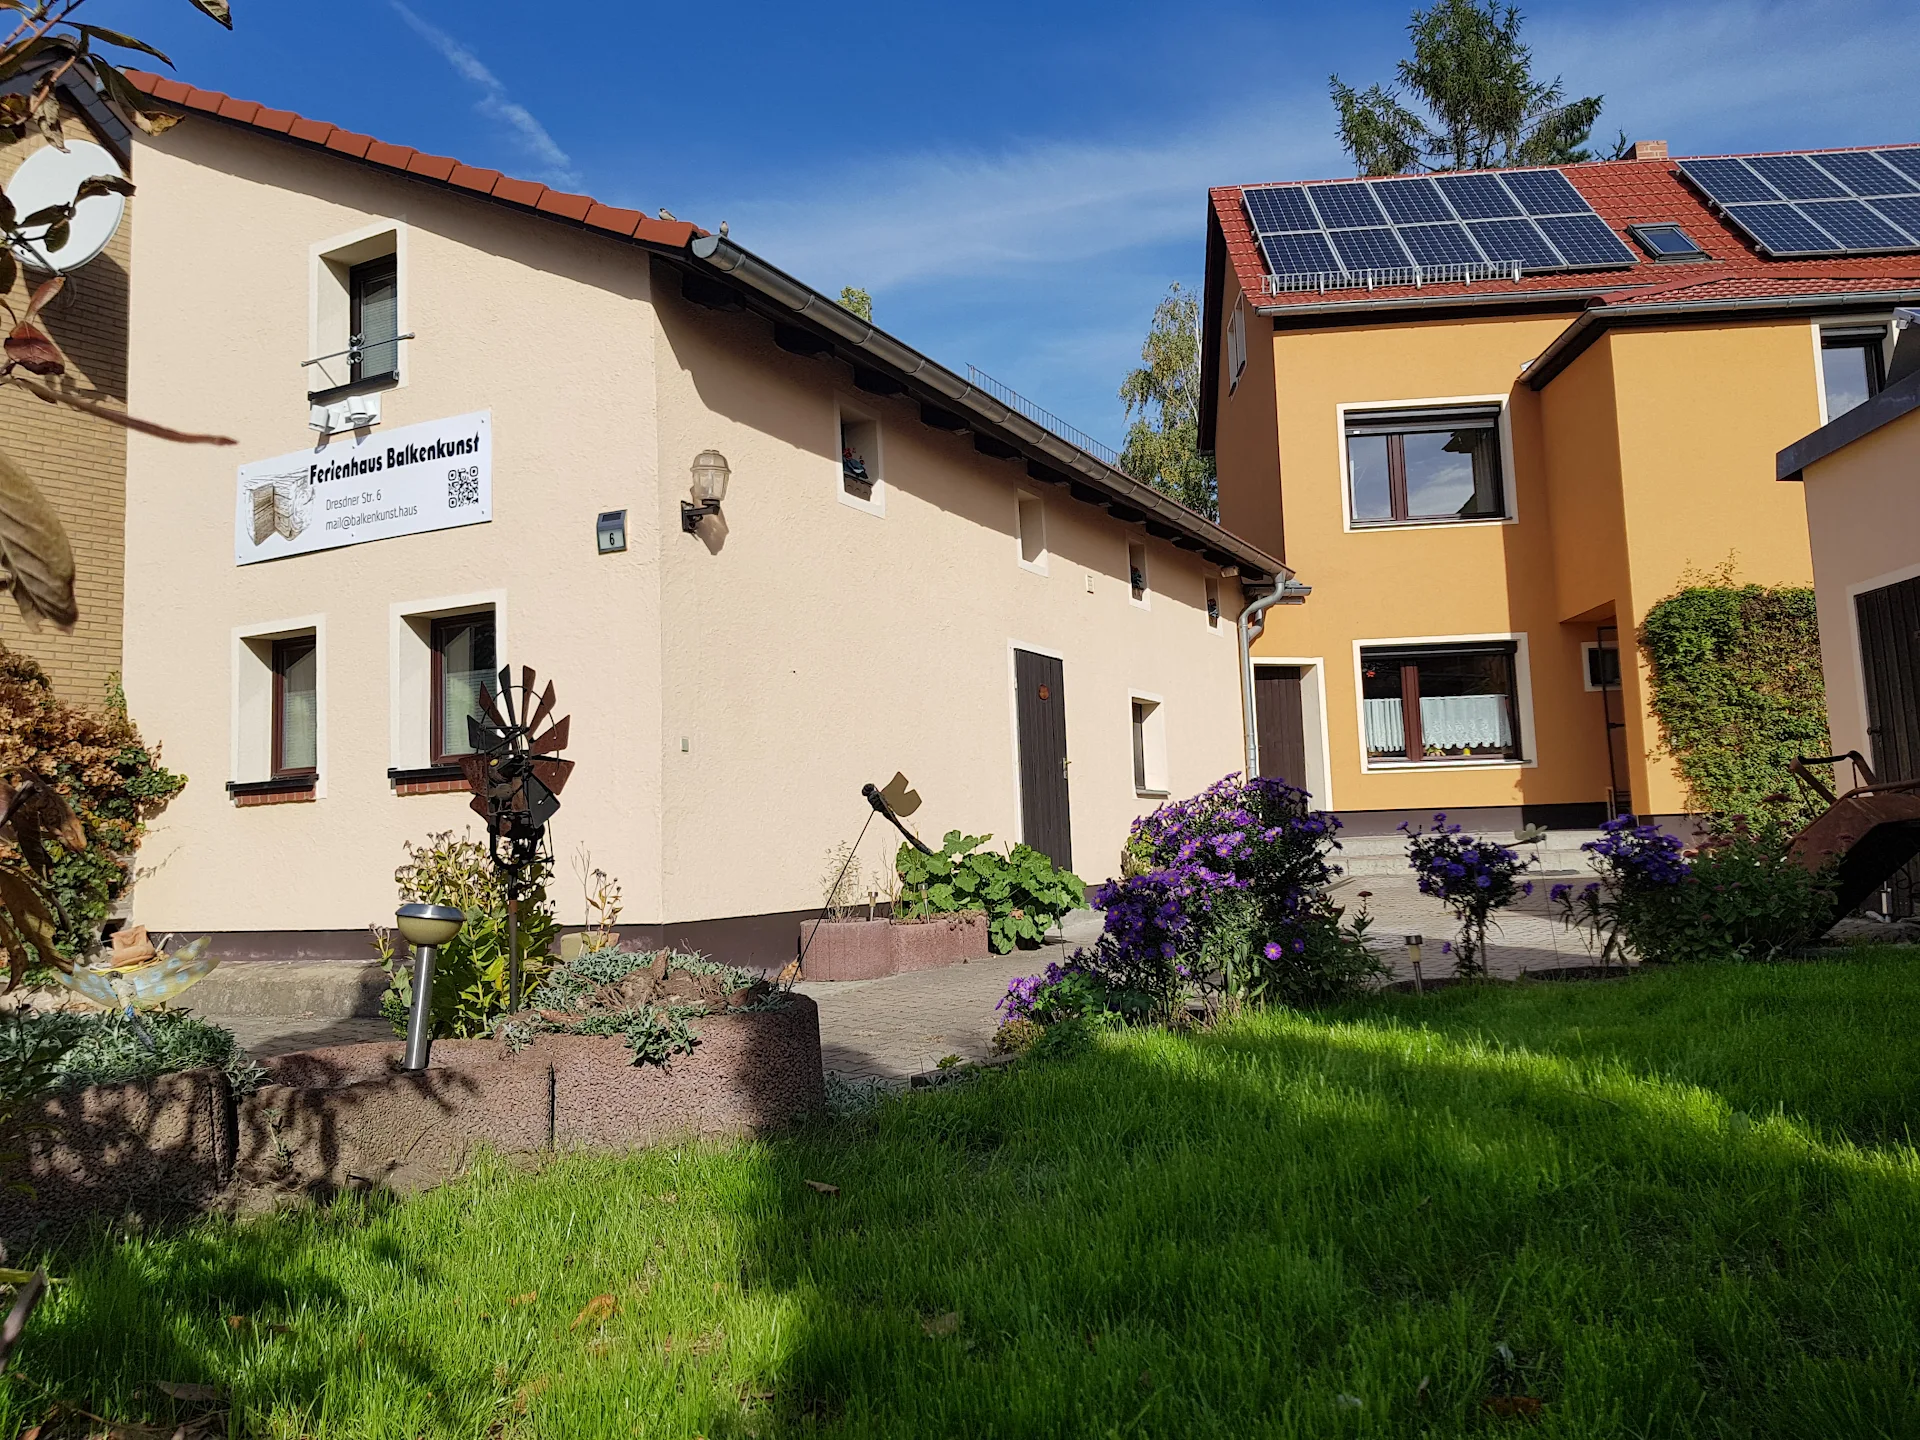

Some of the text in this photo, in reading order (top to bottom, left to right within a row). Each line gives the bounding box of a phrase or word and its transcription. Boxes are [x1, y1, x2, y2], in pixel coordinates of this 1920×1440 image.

[310, 431, 479, 485] Ferienhaus Balkenkunst
[326, 489, 382, 511] Dresdner Str. 6
[326, 504, 418, 531] mail@balkenkunst.haus
[609, 532, 615, 546] 6
